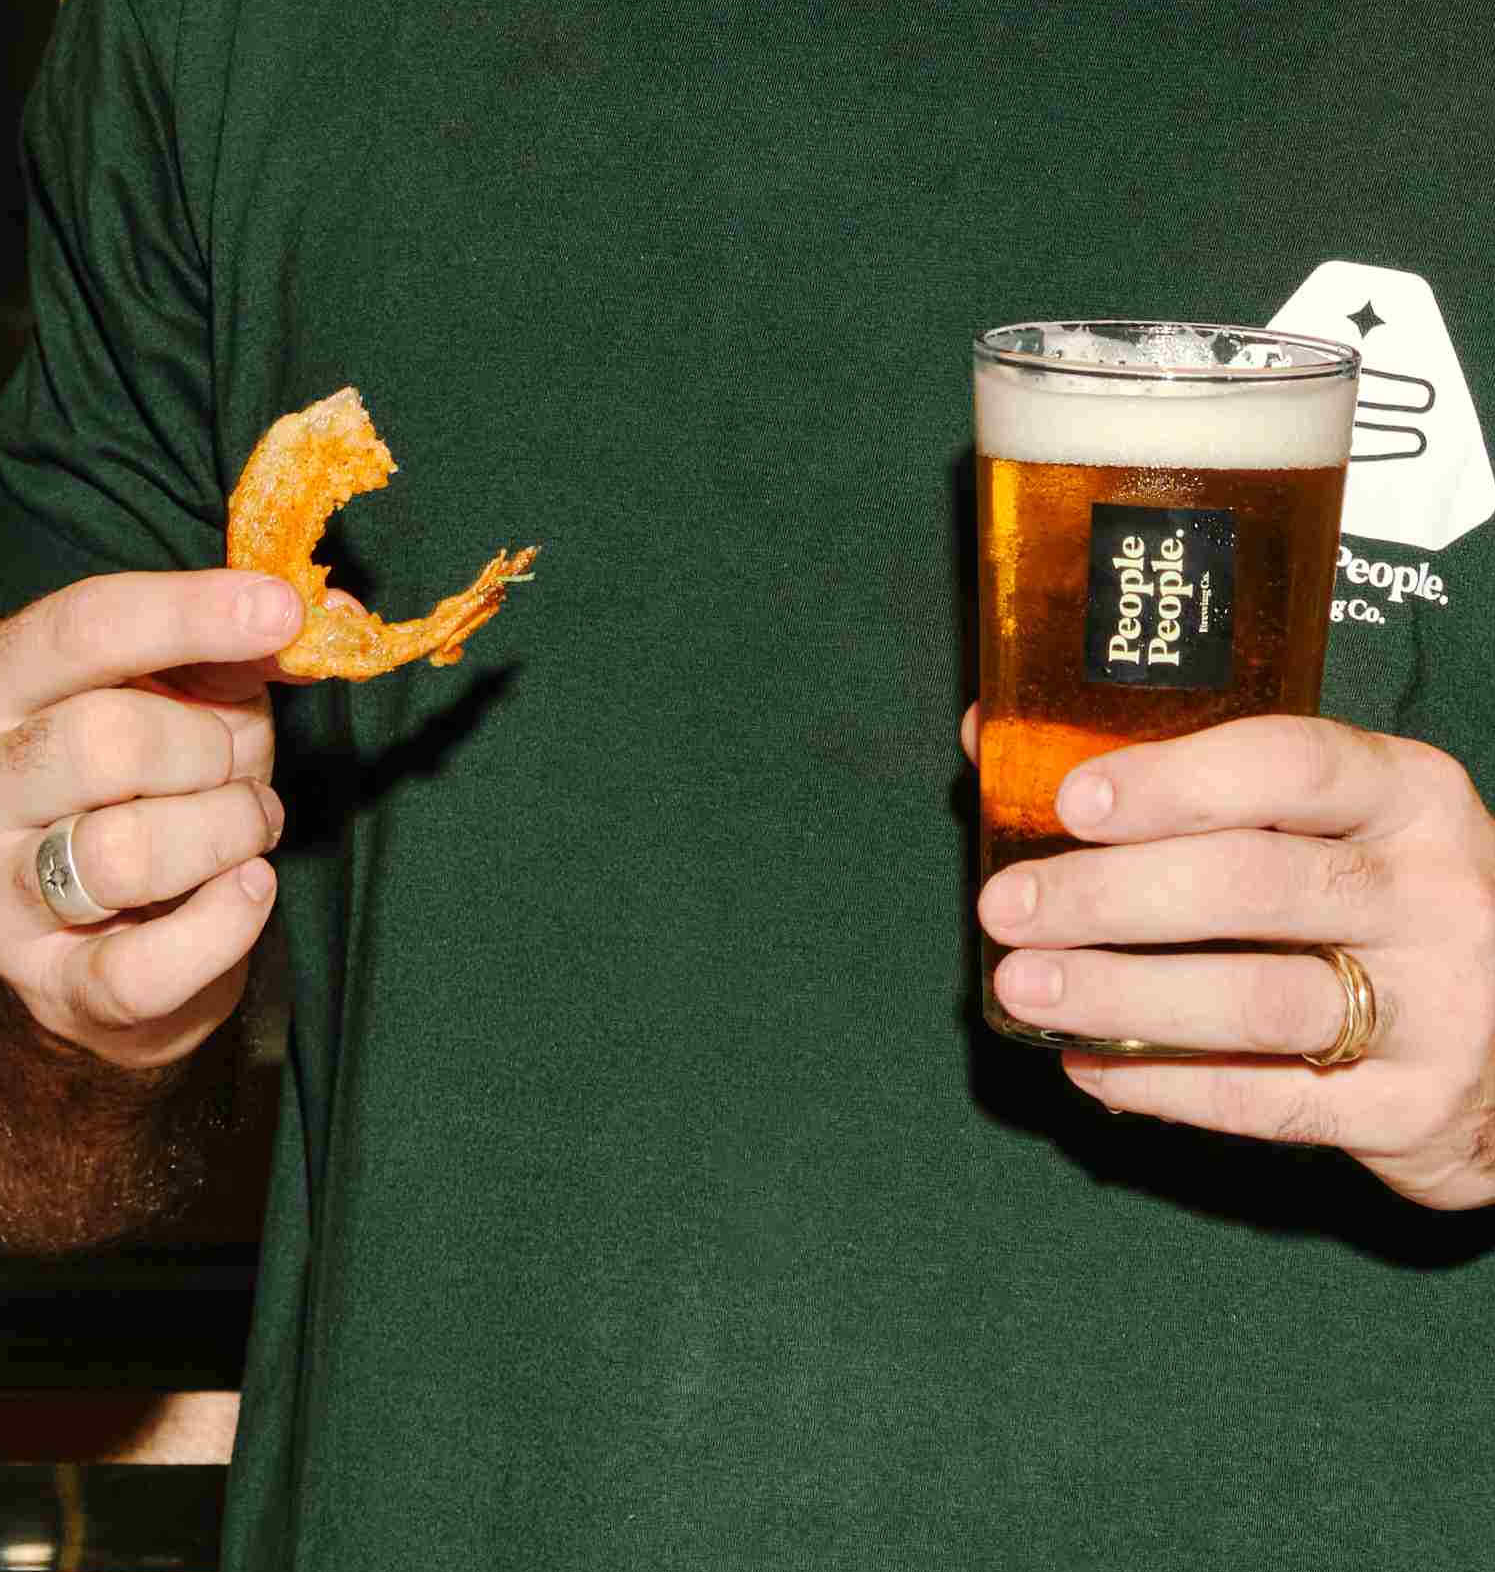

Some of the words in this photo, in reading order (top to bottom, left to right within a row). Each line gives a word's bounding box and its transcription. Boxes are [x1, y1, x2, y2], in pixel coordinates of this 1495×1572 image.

[1108, 535, 1154, 665] People
[1147, 528, 1194, 667] People.
[1347, 599, 1386, 624] Co.
